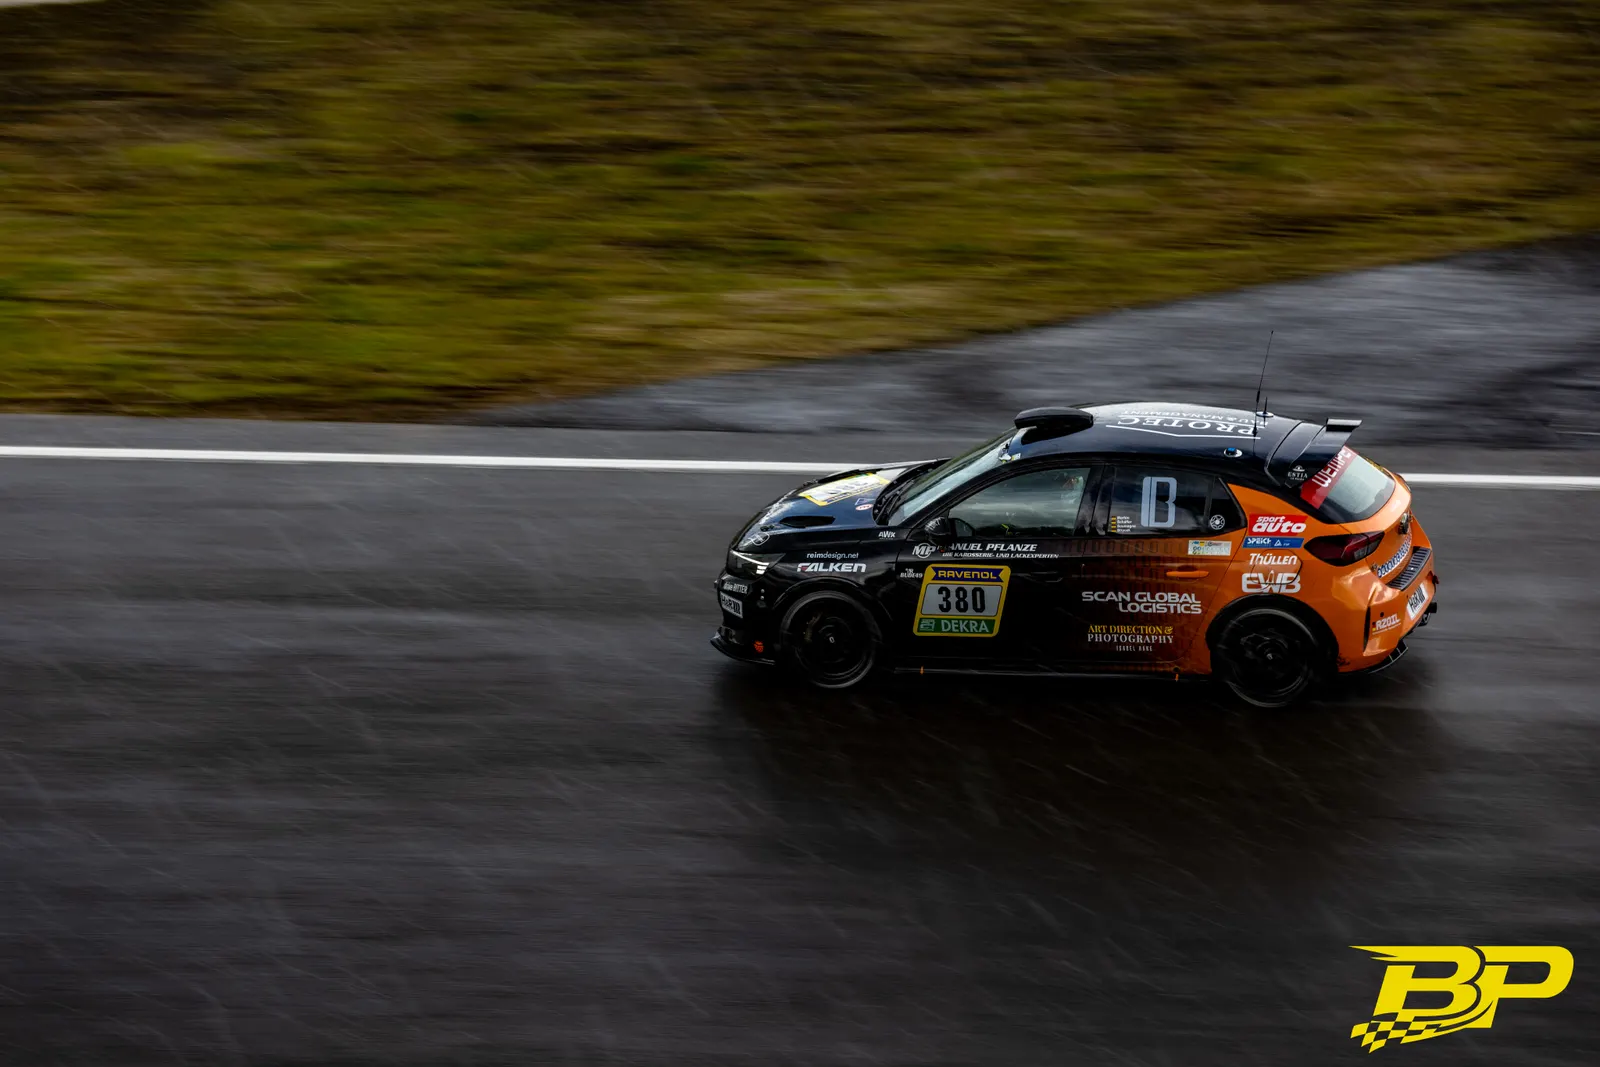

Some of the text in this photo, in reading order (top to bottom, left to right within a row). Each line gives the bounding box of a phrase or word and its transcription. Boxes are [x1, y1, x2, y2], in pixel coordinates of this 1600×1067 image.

[1118, 417, 1256, 436] PROTEC
[1287, 471, 1308, 479] ESTIA
[1256, 515, 1286, 524] sport
[1251, 520, 1307, 533] auto
[912, 543, 936, 559] MP
[937, 543, 1037, 552] ANUEL PFLANZE
[806, 550, 859, 560] reimdesign.net
[796, 562, 867, 573] FALKEN
[937, 569, 997, 580] RAVENOL
[1241, 571, 1301, 594] EWB
[937, 586, 986, 613] 380
[1081, 591, 1201, 604] SCAN GLOBAL
[1118, 602, 1203, 614] LOGISTICS
[941, 619, 989, 633] DEKRA
[1088, 624, 1174, 635] ART DIRECTION &
[1087, 633, 1174, 644] PHOTOGRAPHY
